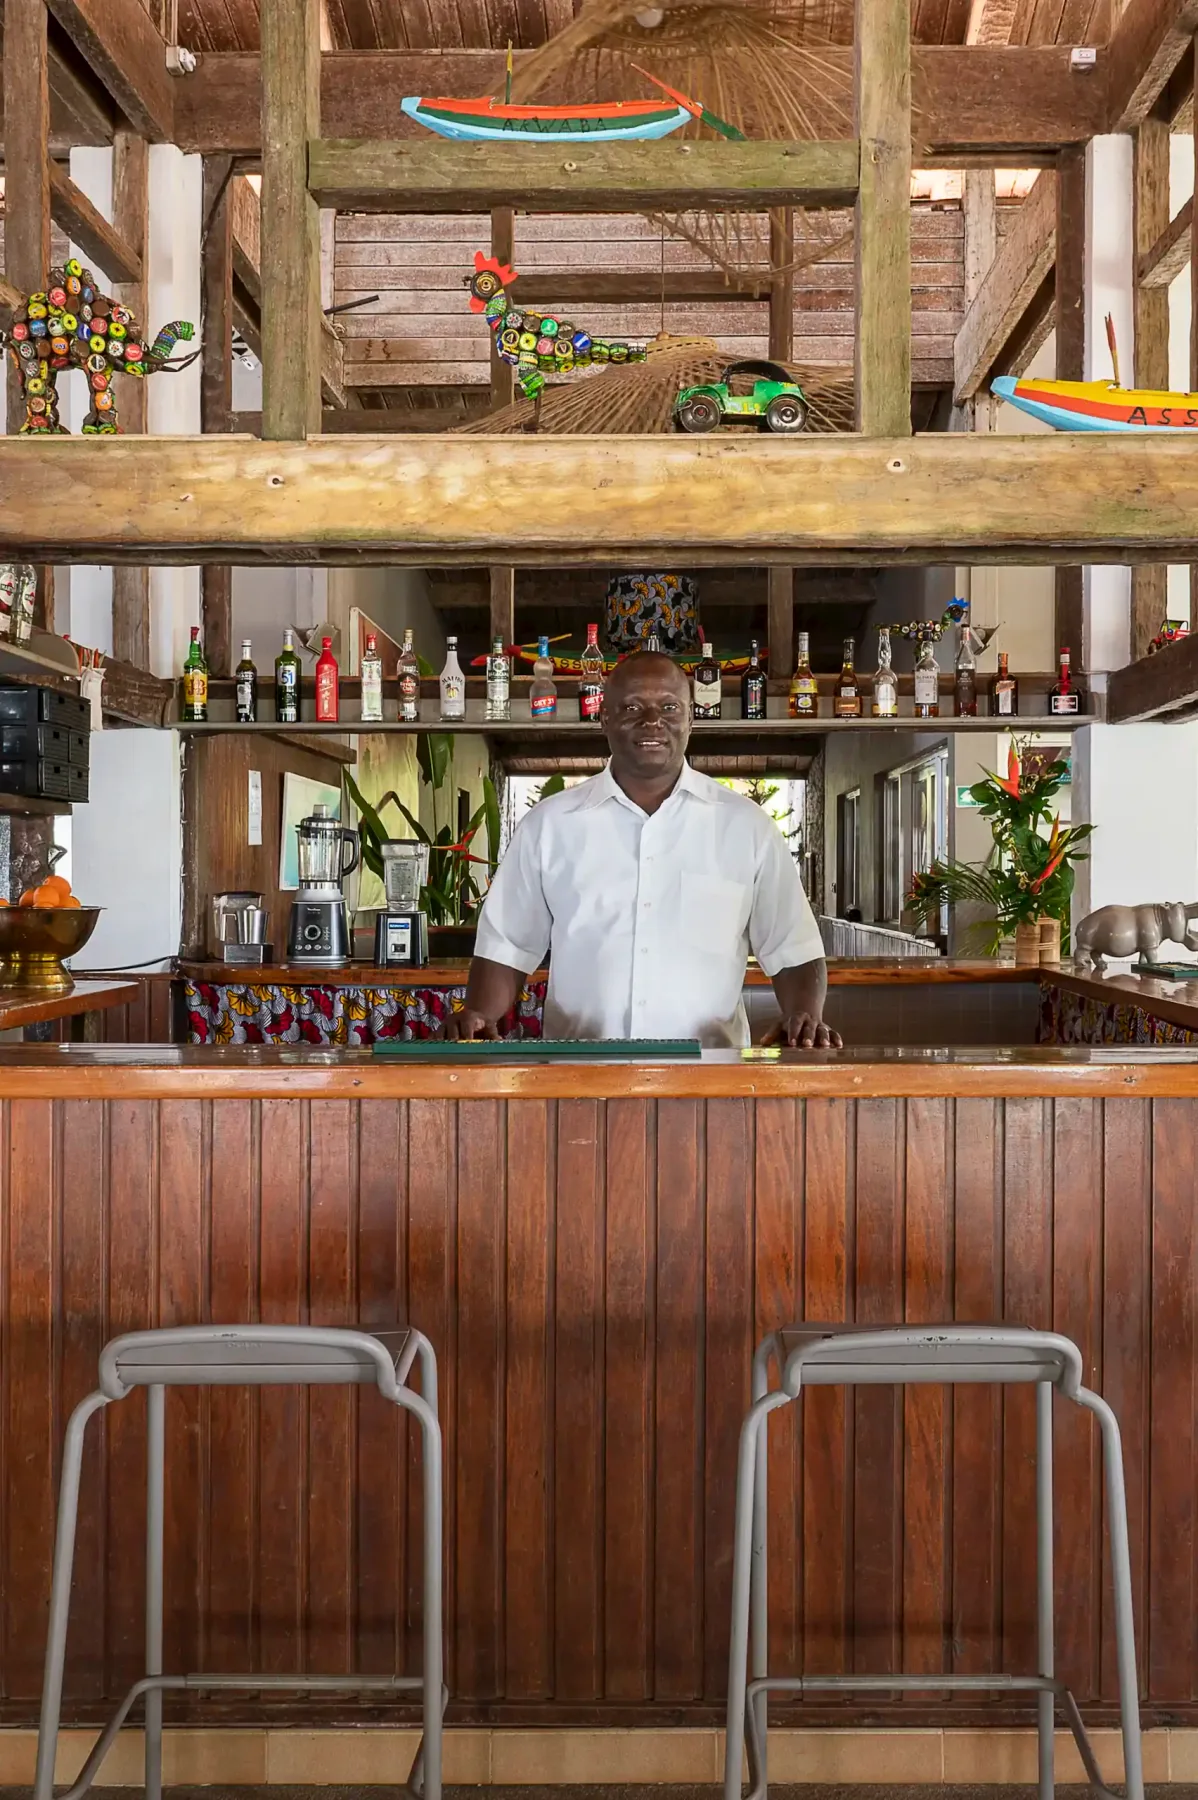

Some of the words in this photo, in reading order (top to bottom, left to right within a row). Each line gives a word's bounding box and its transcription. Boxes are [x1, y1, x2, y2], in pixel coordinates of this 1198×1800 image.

[502, 116, 606, 133] AKWABA
[281, 672, 293, 685] 51
[585, 696, 599, 704] GET
